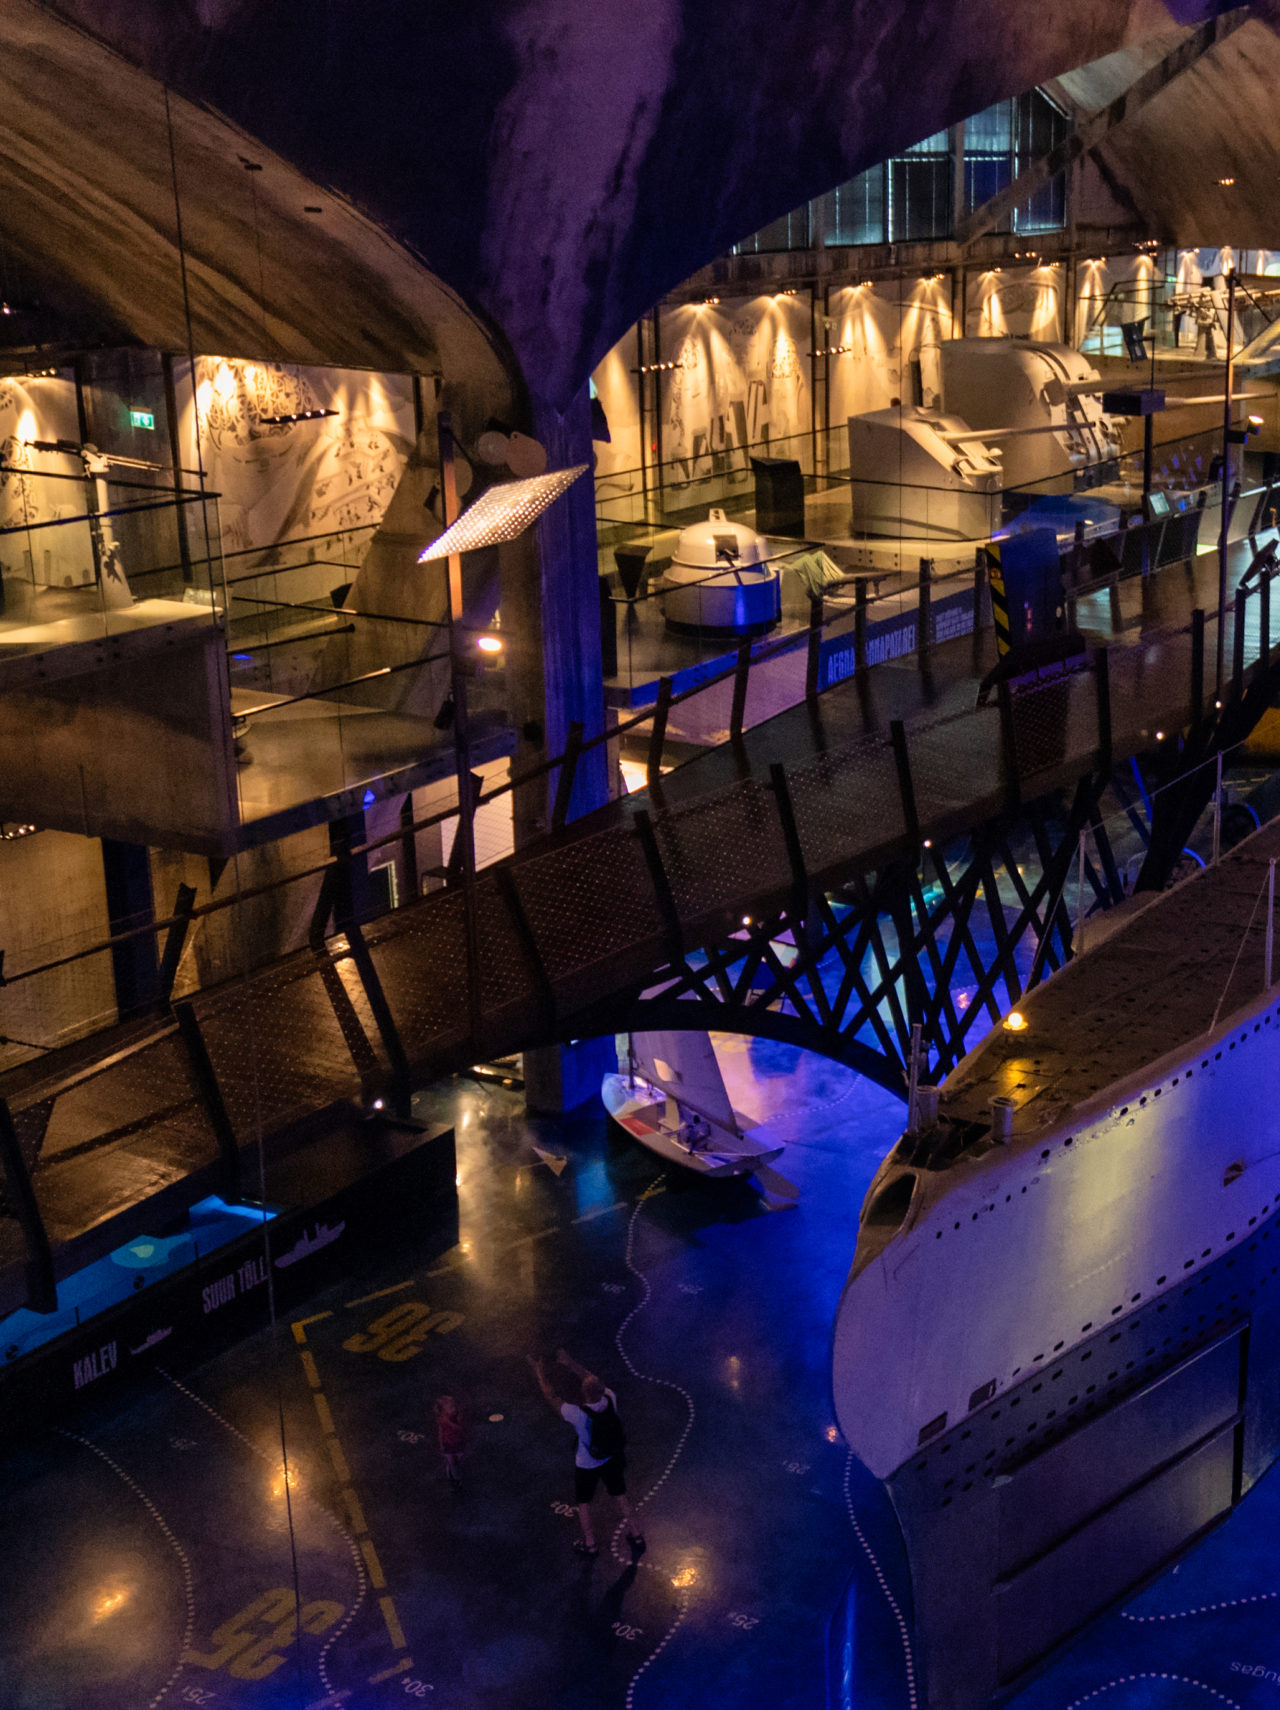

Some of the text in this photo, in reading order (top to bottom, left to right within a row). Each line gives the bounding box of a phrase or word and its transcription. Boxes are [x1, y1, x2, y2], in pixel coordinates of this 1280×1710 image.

[201, 1272, 236, 1315] SUUR
[340, 1301, 466, 1363] 36
[73, 1340, 117, 1390] KALEV
[178, 1587, 345, 1681] 35
